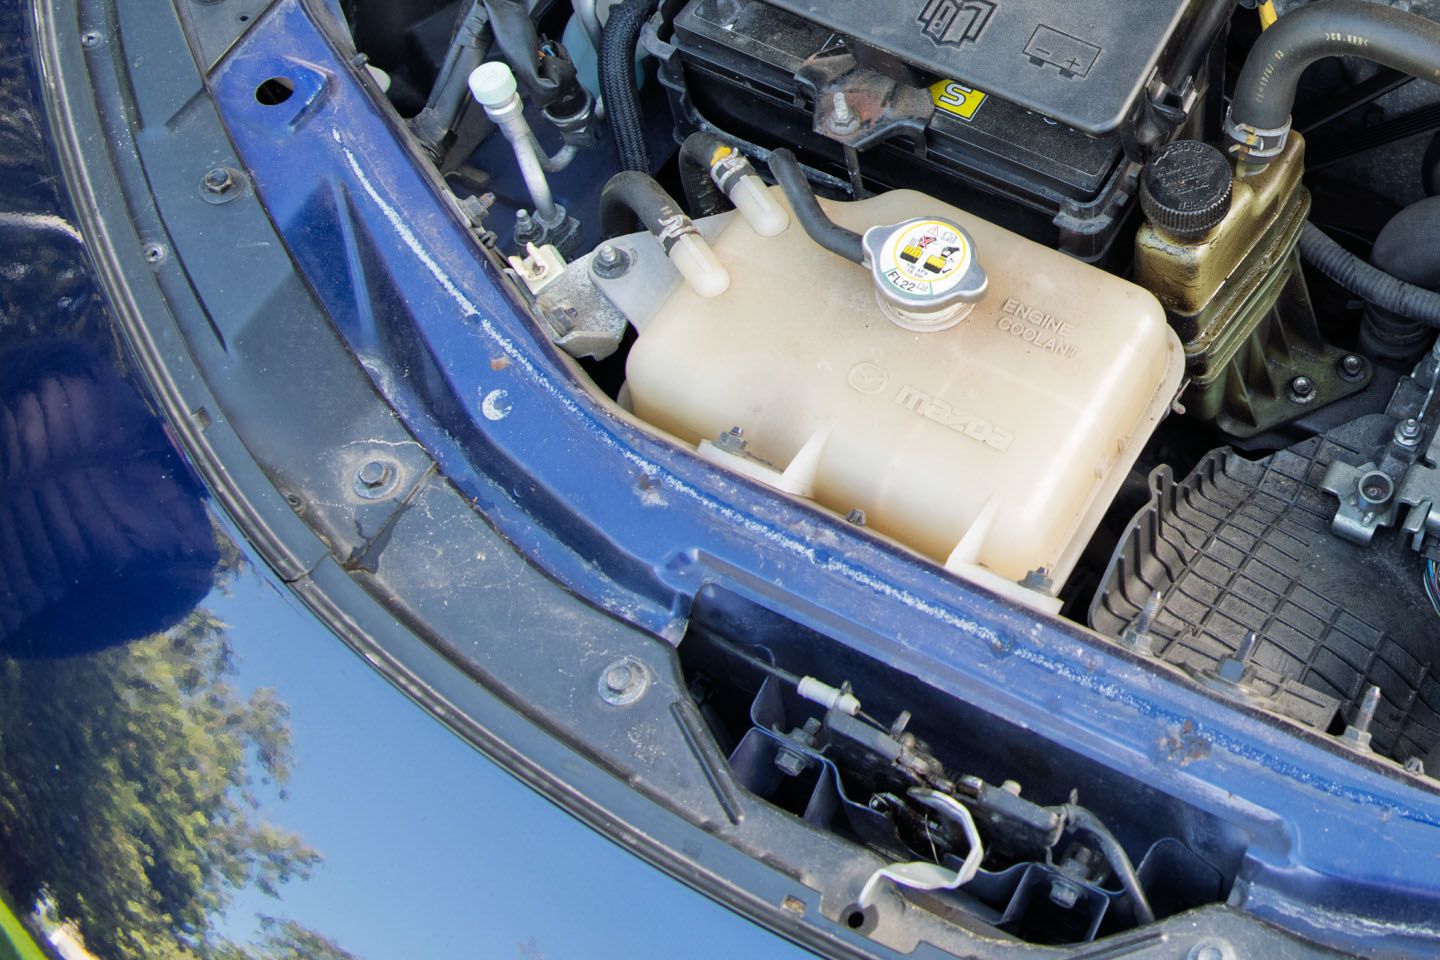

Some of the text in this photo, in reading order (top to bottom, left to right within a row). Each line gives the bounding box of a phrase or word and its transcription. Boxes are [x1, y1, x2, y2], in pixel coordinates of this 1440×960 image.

[940, 83, 972, 106] S
[887, 271, 916, 292] FL22
[1001, 298, 1077, 338] ENGINE
[998, 317, 1080, 361] COOLANT
[895, 384, 1013, 453] mazda
